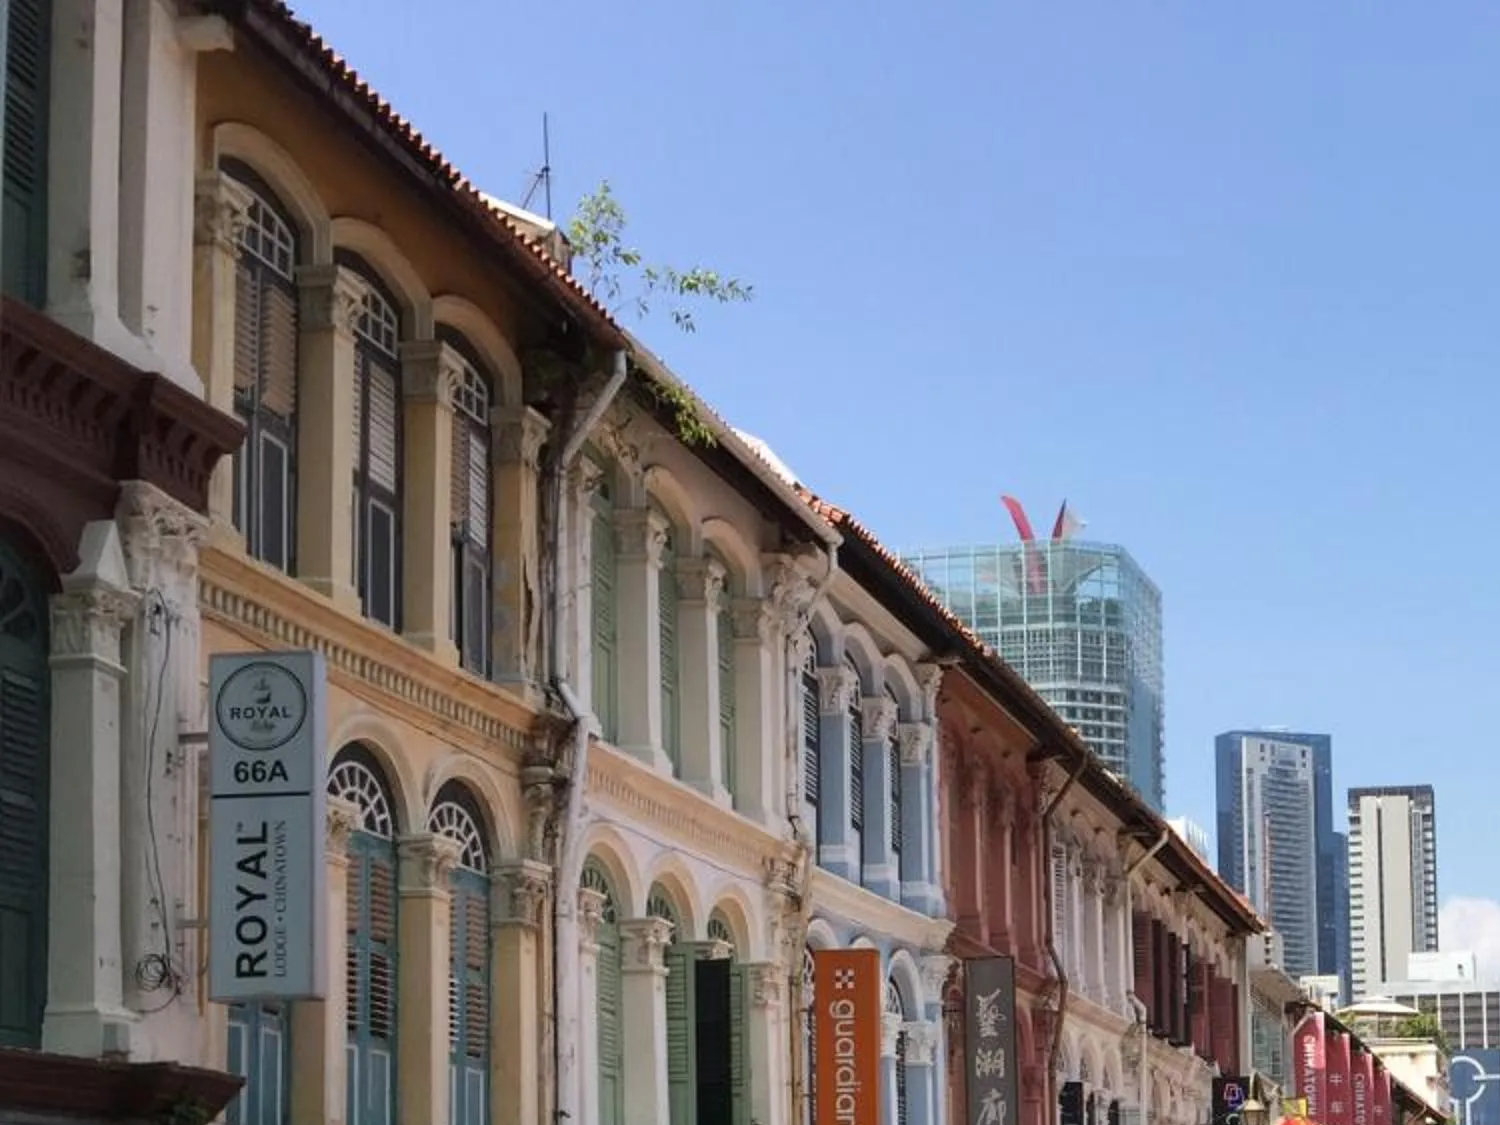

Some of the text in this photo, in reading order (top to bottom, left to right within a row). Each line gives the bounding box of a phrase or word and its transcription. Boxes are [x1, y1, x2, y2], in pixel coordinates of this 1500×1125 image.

[229, 706, 292, 719] ROYAL
[234, 760, 289, 783] 66A
[235, 820, 268, 979] ROYAL
[274, 819, 287, 978] LODGE CHINATOWN
[1303, 1034, 1317, 1116] CHINATOWN
